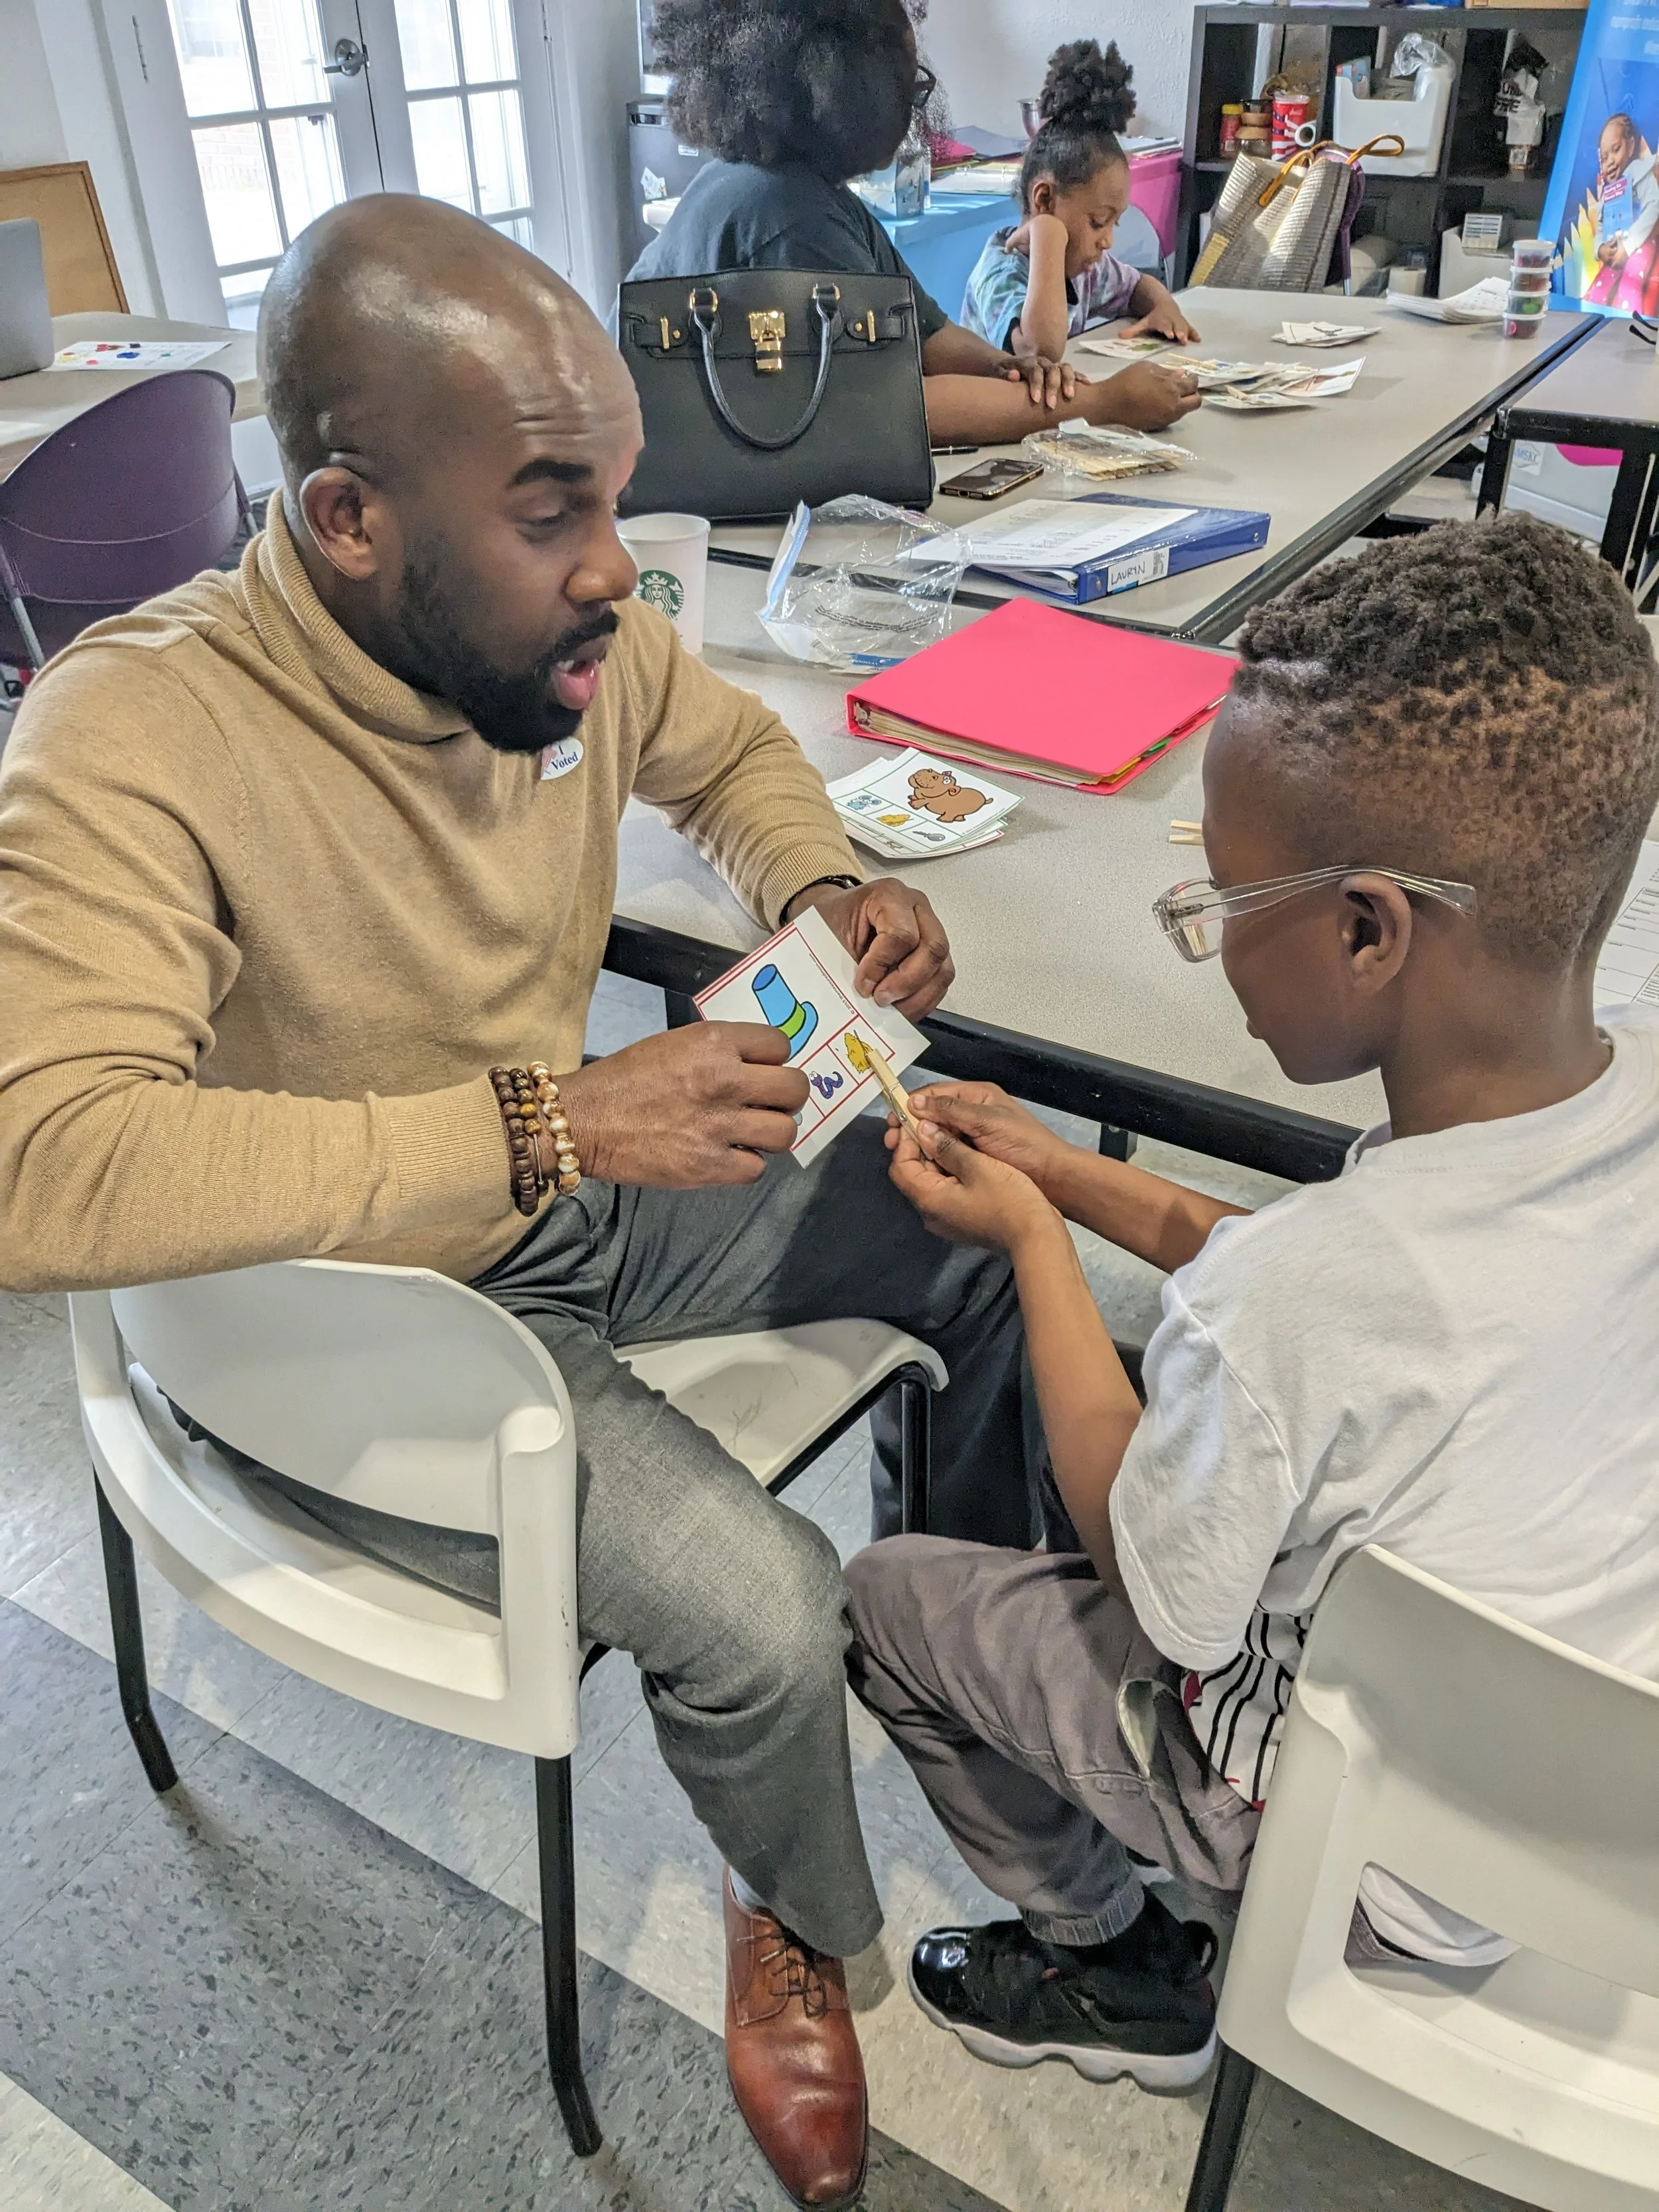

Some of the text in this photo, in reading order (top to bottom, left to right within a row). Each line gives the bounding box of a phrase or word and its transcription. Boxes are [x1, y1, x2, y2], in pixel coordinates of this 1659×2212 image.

[1111, 560, 1145, 585] LAURYN
[558, 745, 564, 755] I
[551, 751, 579, 770] Voted
